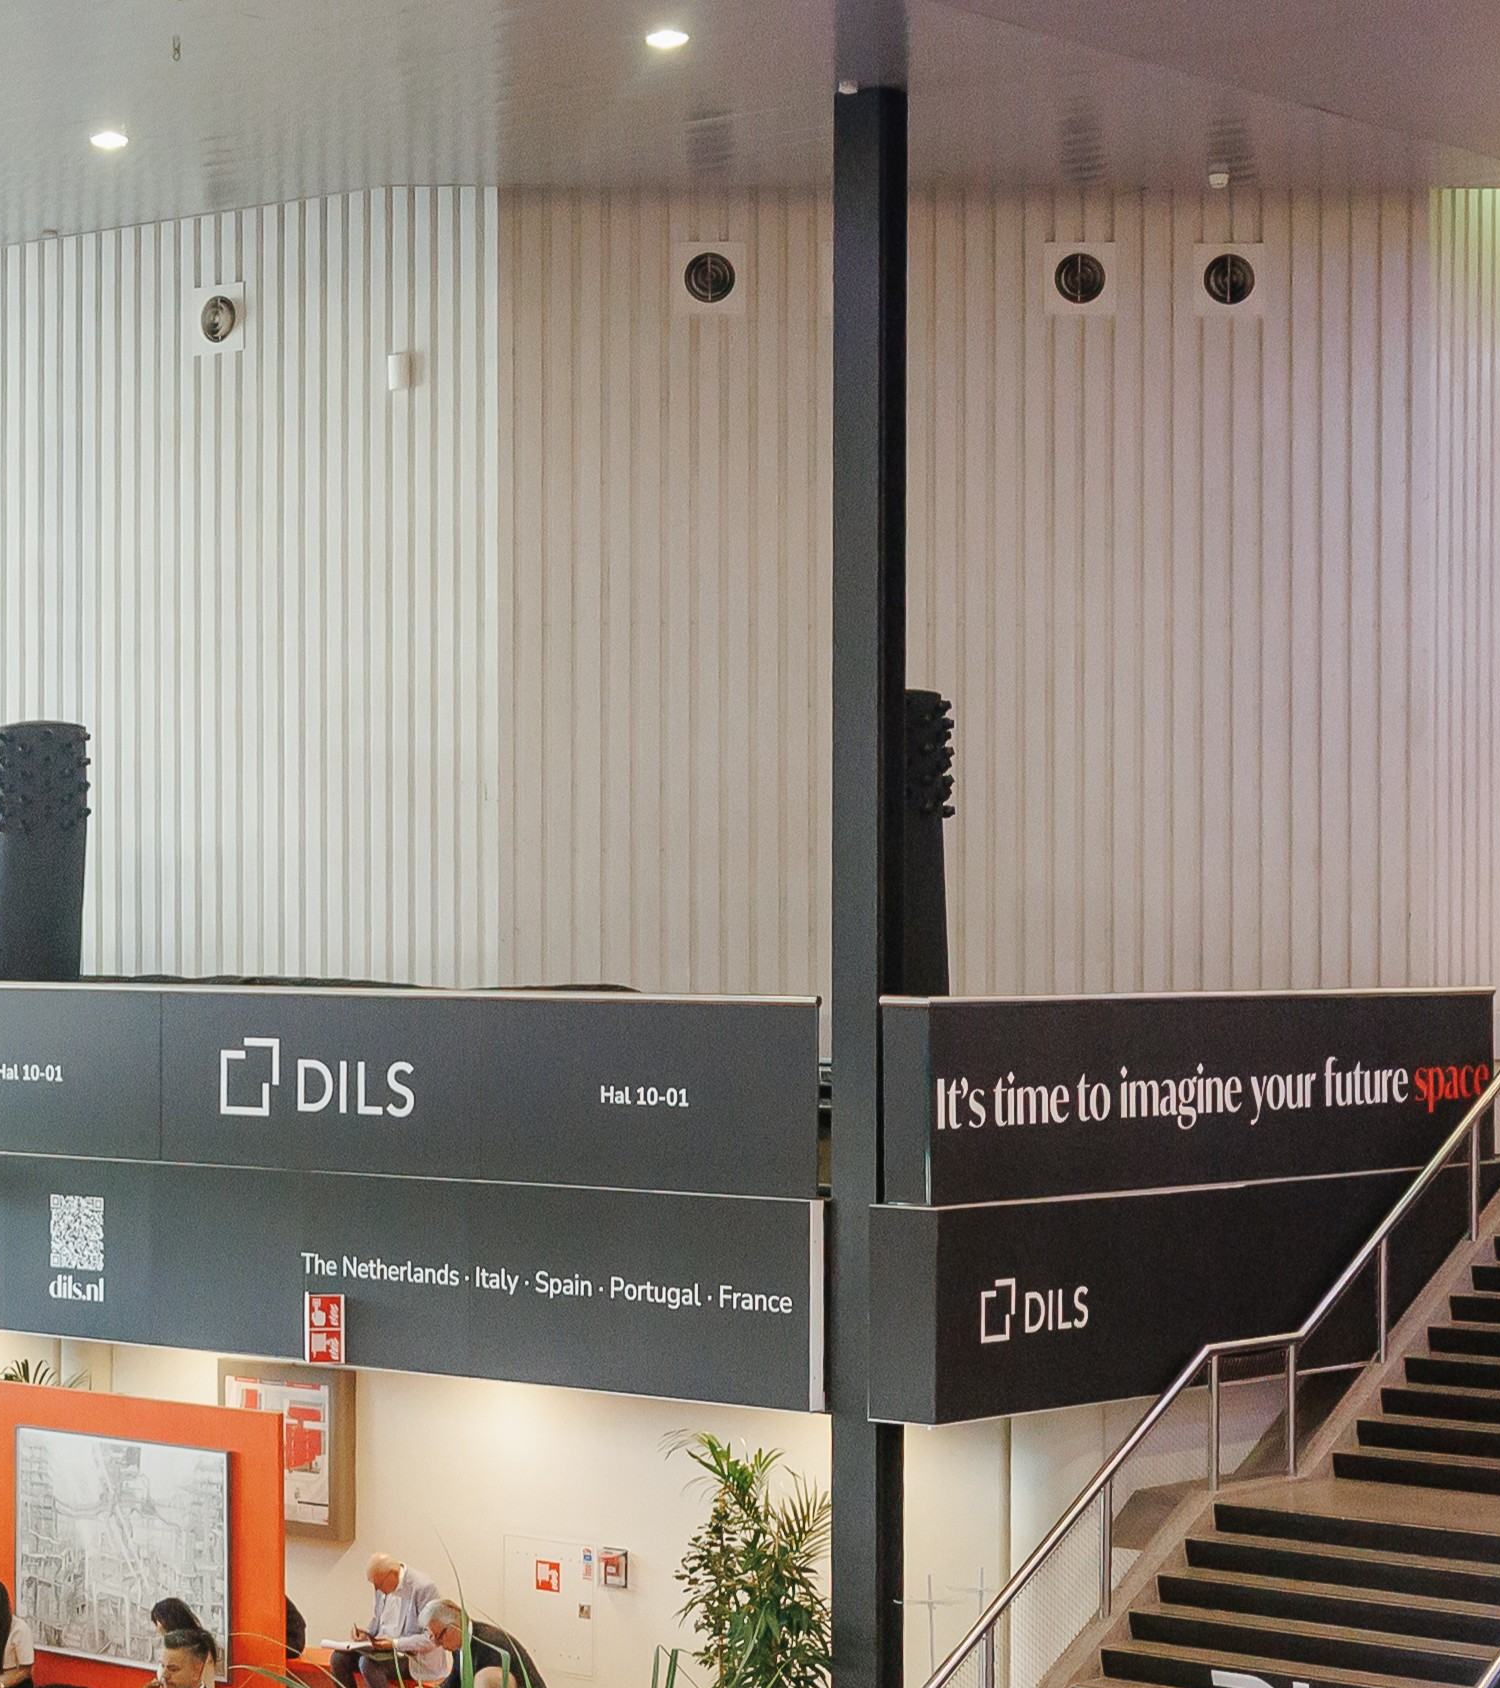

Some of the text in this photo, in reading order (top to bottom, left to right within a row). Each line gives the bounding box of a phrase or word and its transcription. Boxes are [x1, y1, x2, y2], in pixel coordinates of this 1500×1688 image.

[22, 1064, 63, 1083] 10-01
[297, 1058, 416, 1118] DILS
[600, 1085, 690, 1108] Hal 10-01
[936, 1056, 1489, 1130] It's time to imagine your future space
[49, 1274, 105, 1302] dils.nl
[301, 1253, 794, 1314] The Netherlands Italy Spain Portugal France
[1024, 1285, 1089, 1334] DILS
